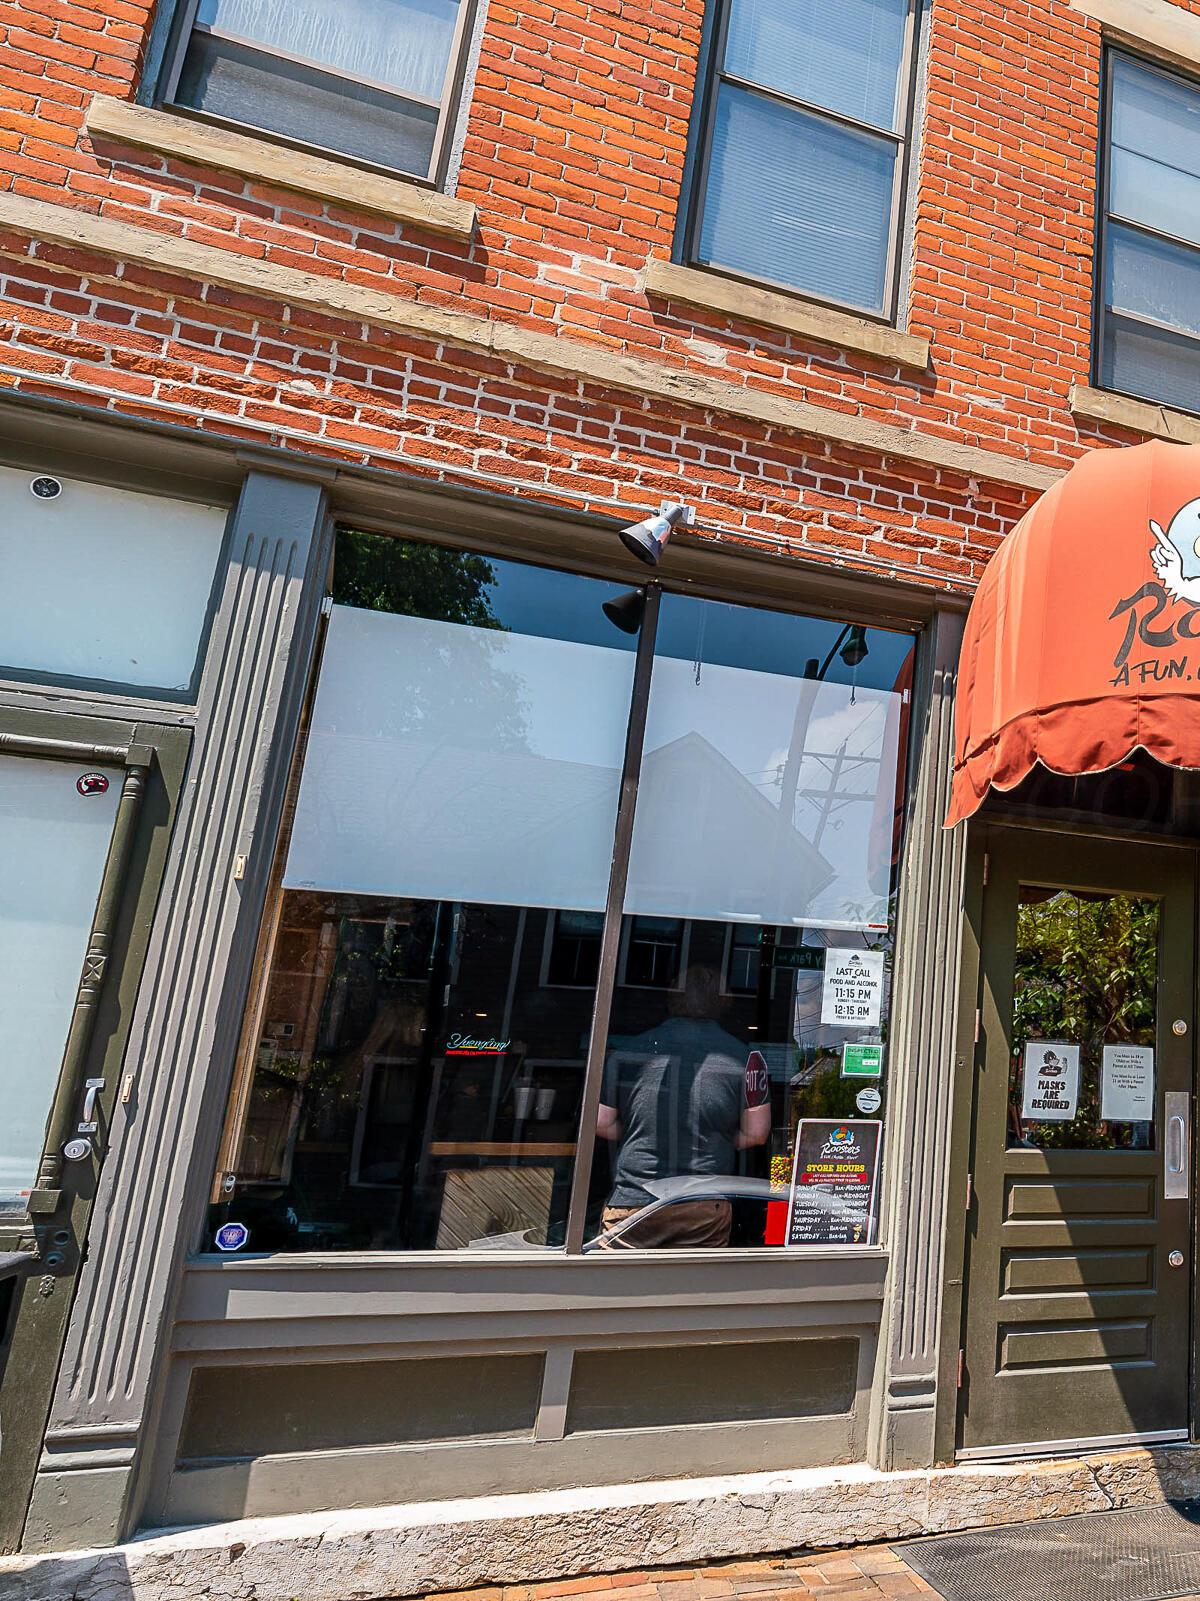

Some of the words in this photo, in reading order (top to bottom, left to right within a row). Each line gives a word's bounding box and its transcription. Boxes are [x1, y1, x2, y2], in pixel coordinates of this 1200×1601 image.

[1109, 662, 1130, 687] A
[836, 967, 853, 976] LAST
[854, 968, 871, 978] CALL
[835, 987, 855, 998] 11:15
[858, 989, 871, 1000] PM
[834, 1004, 855, 1015] 12:15
[857, 1006, 870, 1016] AM
[1038, 1080, 1066, 1090] MASKS
[1043, 1090, 1060, 1099] ARE
[1031, 1099, 1070, 1110] REQUIRED
[820, 1142, 861, 1156] Roosters
[806, 1164, 834, 1173] STORE
[835, 1164, 865, 1173] HOURS
